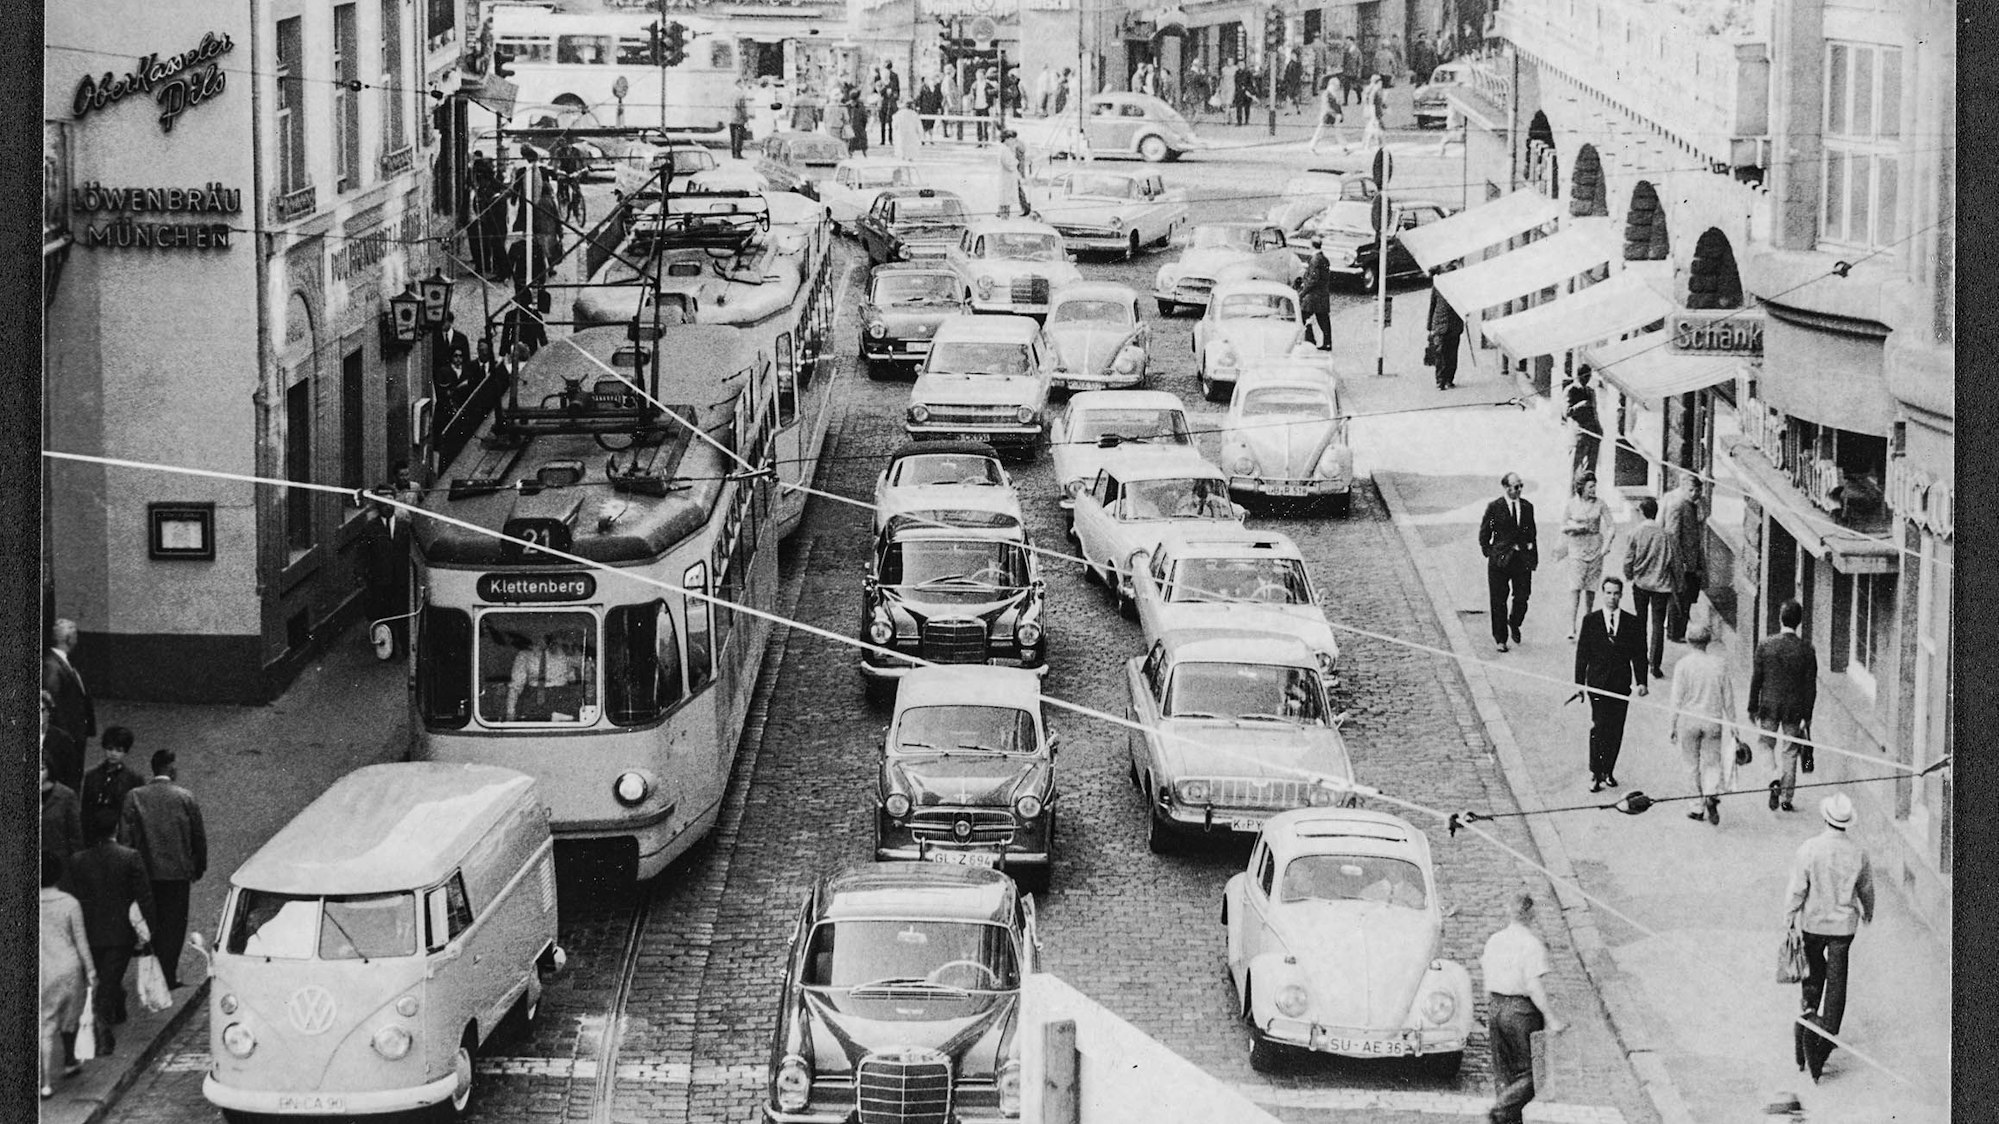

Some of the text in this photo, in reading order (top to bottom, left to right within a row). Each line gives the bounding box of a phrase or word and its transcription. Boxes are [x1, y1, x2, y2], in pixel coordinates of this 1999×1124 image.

[158, 63, 226, 133] Pils
[72, 181, 242, 213] LÖWENBRÄU
[86, 217, 231, 249] MÜNCHEN
[522, 528, 551, 555] 21
[490, 579, 586, 596] Klettenberg
